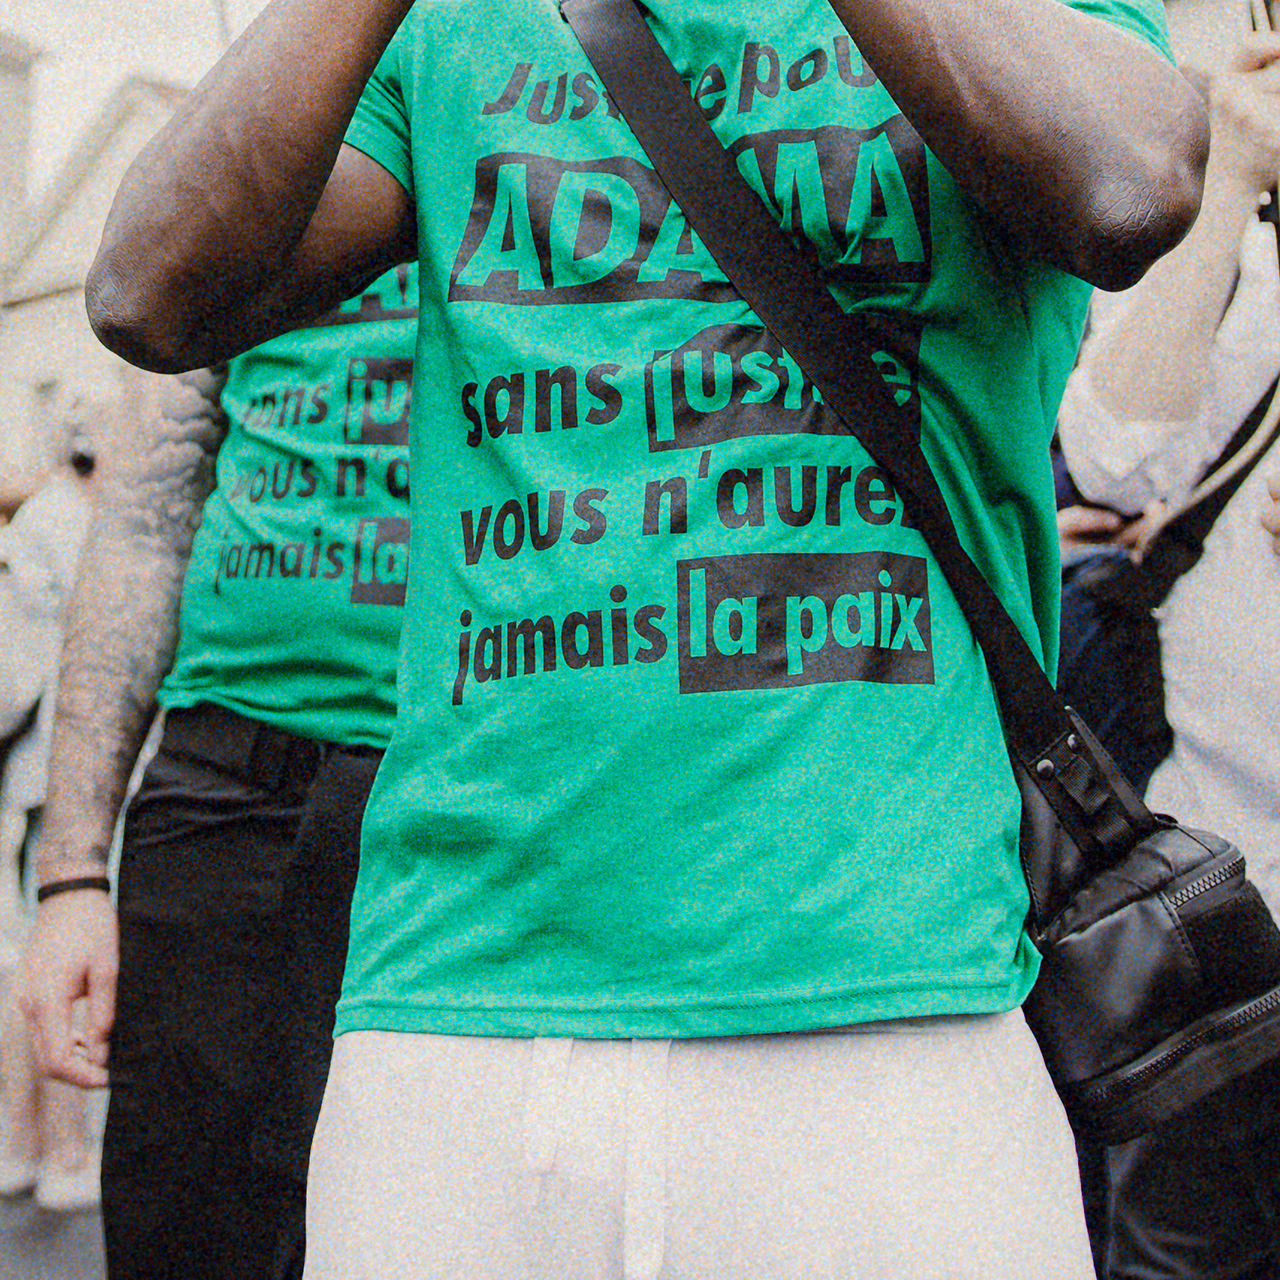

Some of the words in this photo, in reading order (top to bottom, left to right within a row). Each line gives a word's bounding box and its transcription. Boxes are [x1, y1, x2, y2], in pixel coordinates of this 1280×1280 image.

[737, 35, 880, 115] pou
[461, 362, 624, 449] sans
[460, 485, 610, 568] vous
[642, 449, 916, 536] n'aure
[451, 584, 668, 706] jamais
[687, 566, 760, 659] la
[785, 568, 928, 677] paix
